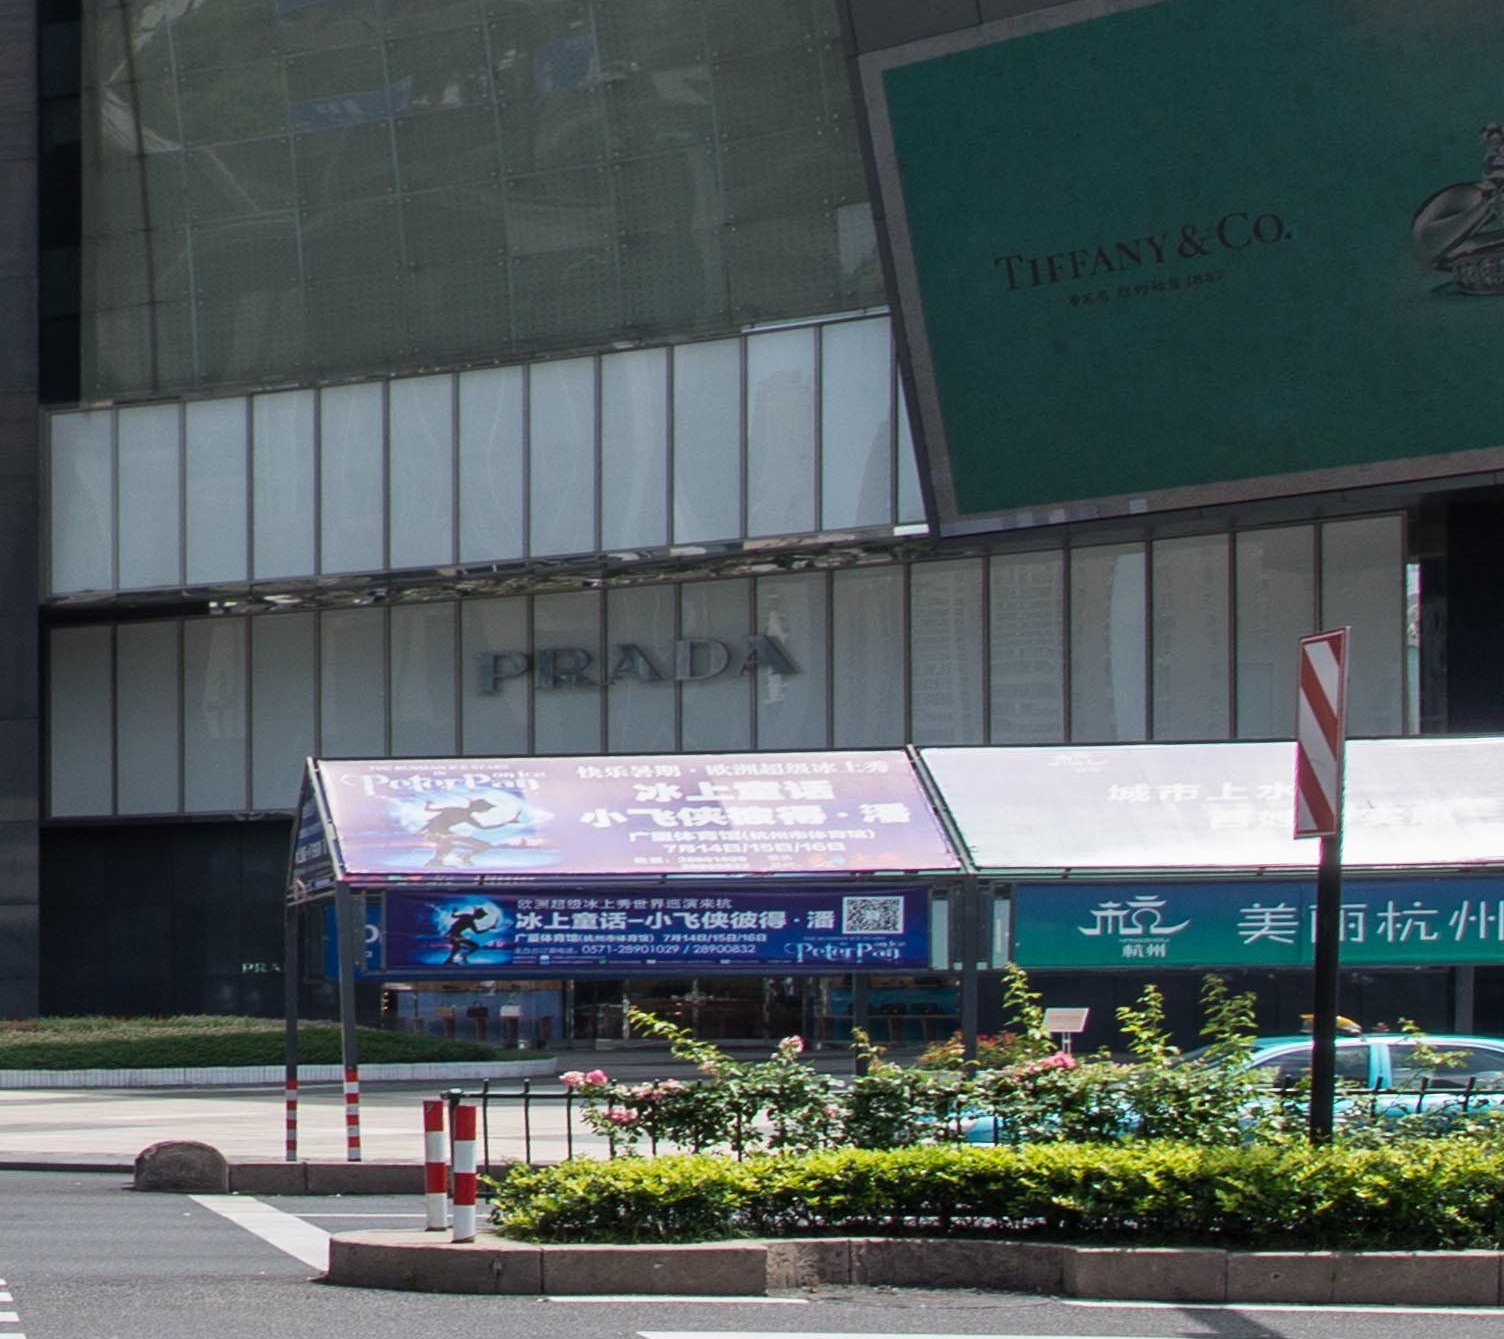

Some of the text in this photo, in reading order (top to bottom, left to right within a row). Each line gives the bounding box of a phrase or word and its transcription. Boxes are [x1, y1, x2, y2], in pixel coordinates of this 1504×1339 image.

[994, 231, 1170, 292] TIFFANY
[475, 633, 803, 696] PRADA
[633, 780, 836, 802] 冰上童话
